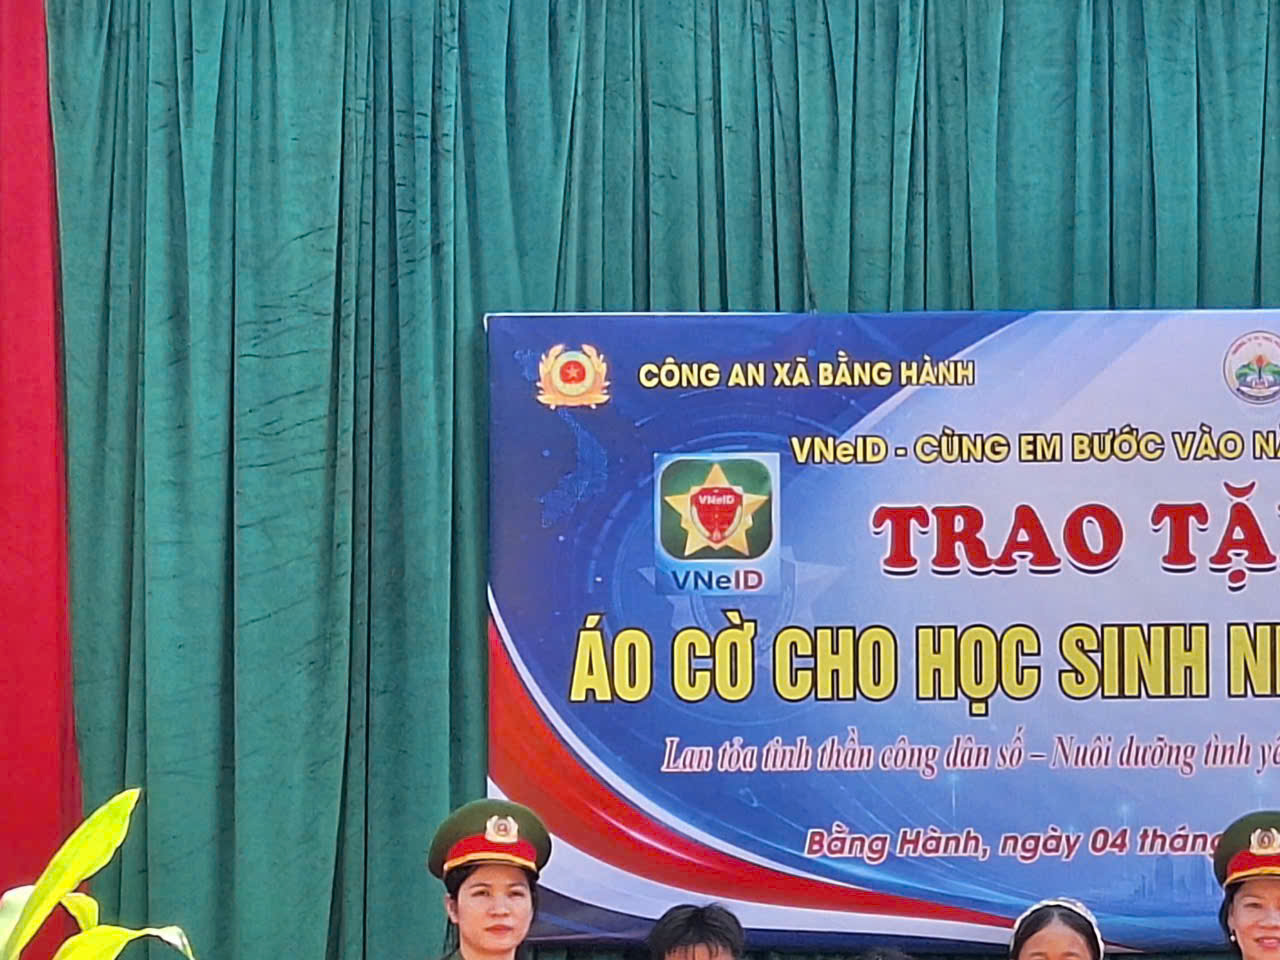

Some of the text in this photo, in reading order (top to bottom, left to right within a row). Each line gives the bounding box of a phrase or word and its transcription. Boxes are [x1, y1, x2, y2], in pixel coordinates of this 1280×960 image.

[638, 350, 975, 388] CÔNG AN XÃ BẰNG HÀNH
[789, 435, 888, 465] VNeID
[914, 426, 1011, 464] CÙNG
[1018, 433, 1063, 462] EM
[1072, 425, 1165, 461] BƯỚC
[1172, 423, 1244, 460] VÀO
[698, 495, 735, 504] VNeID
[872, 503, 1124, 575] TRAO
[671, 570, 764, 590] VNeID
[569, 613, 654, 702] ÁO
[671, 609, 757, 702] CỜ
[772, 624, 898, 702] CHO
[915, 624, 1041, 717] HỌC
[1058, 623, 1210, 700] SINH
[662, 737, 713, 772] Lan
[717, 737, 757, 772] tỏa
[817, 726, 874, 771] thần
[879, 735, 939, 779] công
[944, 735, 990, 769] dân
[995, 726, 1025, 768] số
[1051, 735, 1112, 767] Nuôi
[1117, 735, 1196, 776] dưỡng
[1202, 734, 1251, 767] tình
[804, 821, 890, 863] Bằng
[896, 825, 991, 861] Hành,
[999, 824, 1083, 863] ngày
[1090, 827, 1128, 855] 04
